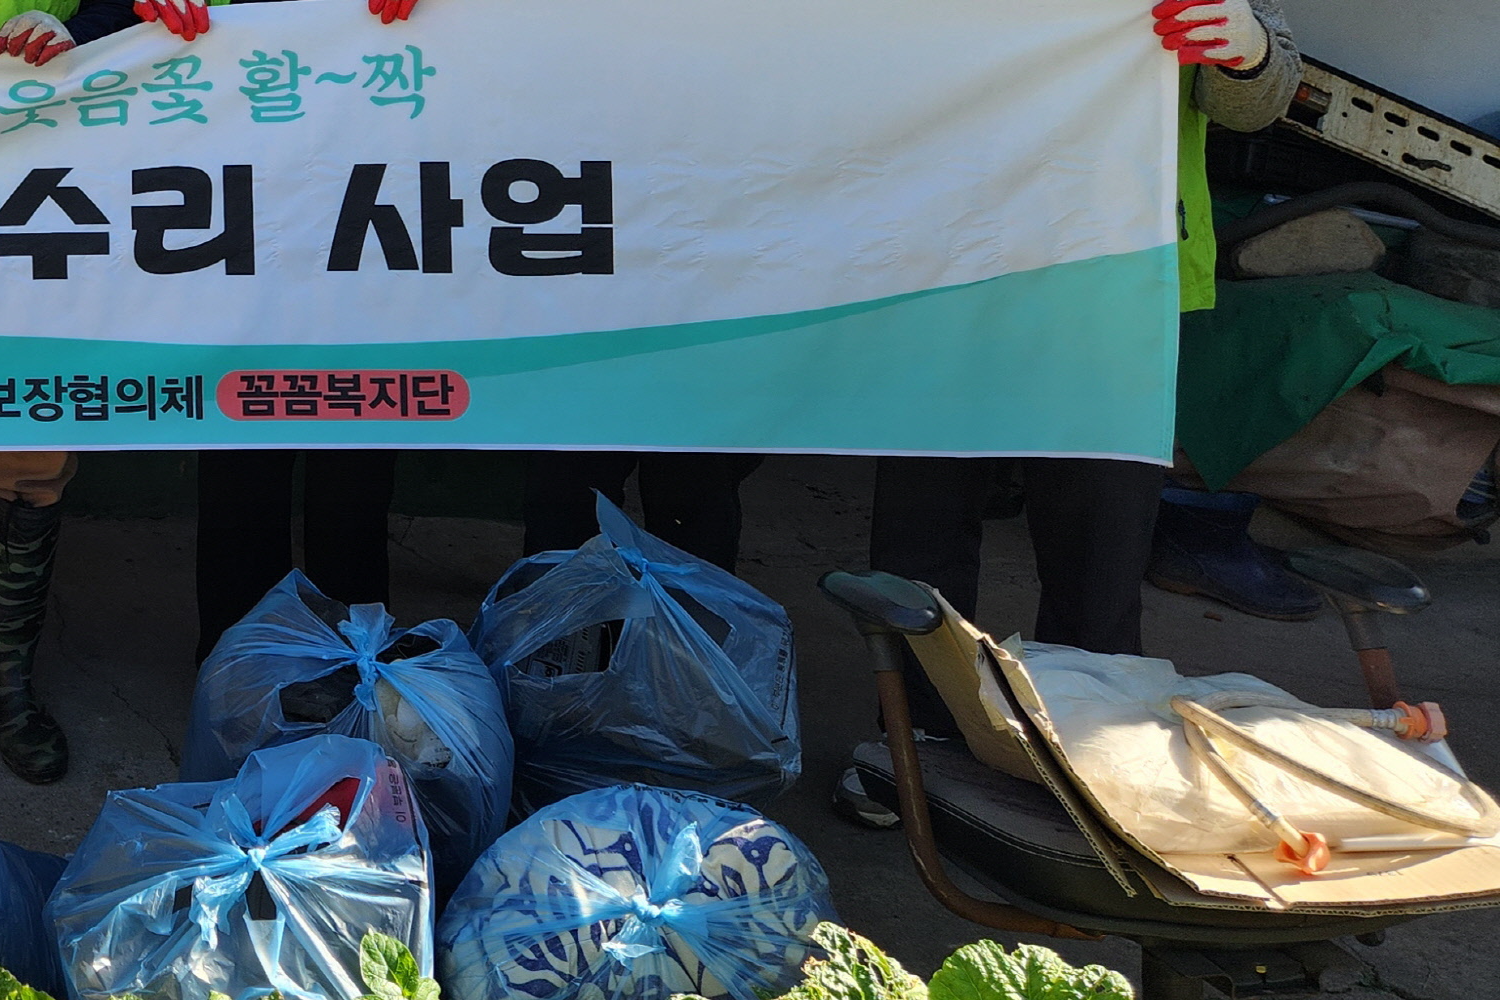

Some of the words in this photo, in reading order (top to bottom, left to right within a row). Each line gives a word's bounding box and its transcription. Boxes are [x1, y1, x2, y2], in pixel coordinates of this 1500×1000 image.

[239, 44, 438, 125] 활~짝
[326, 158, 616, 279] 사업
[237, 373, 456, 420] 꼼꼼복지단
